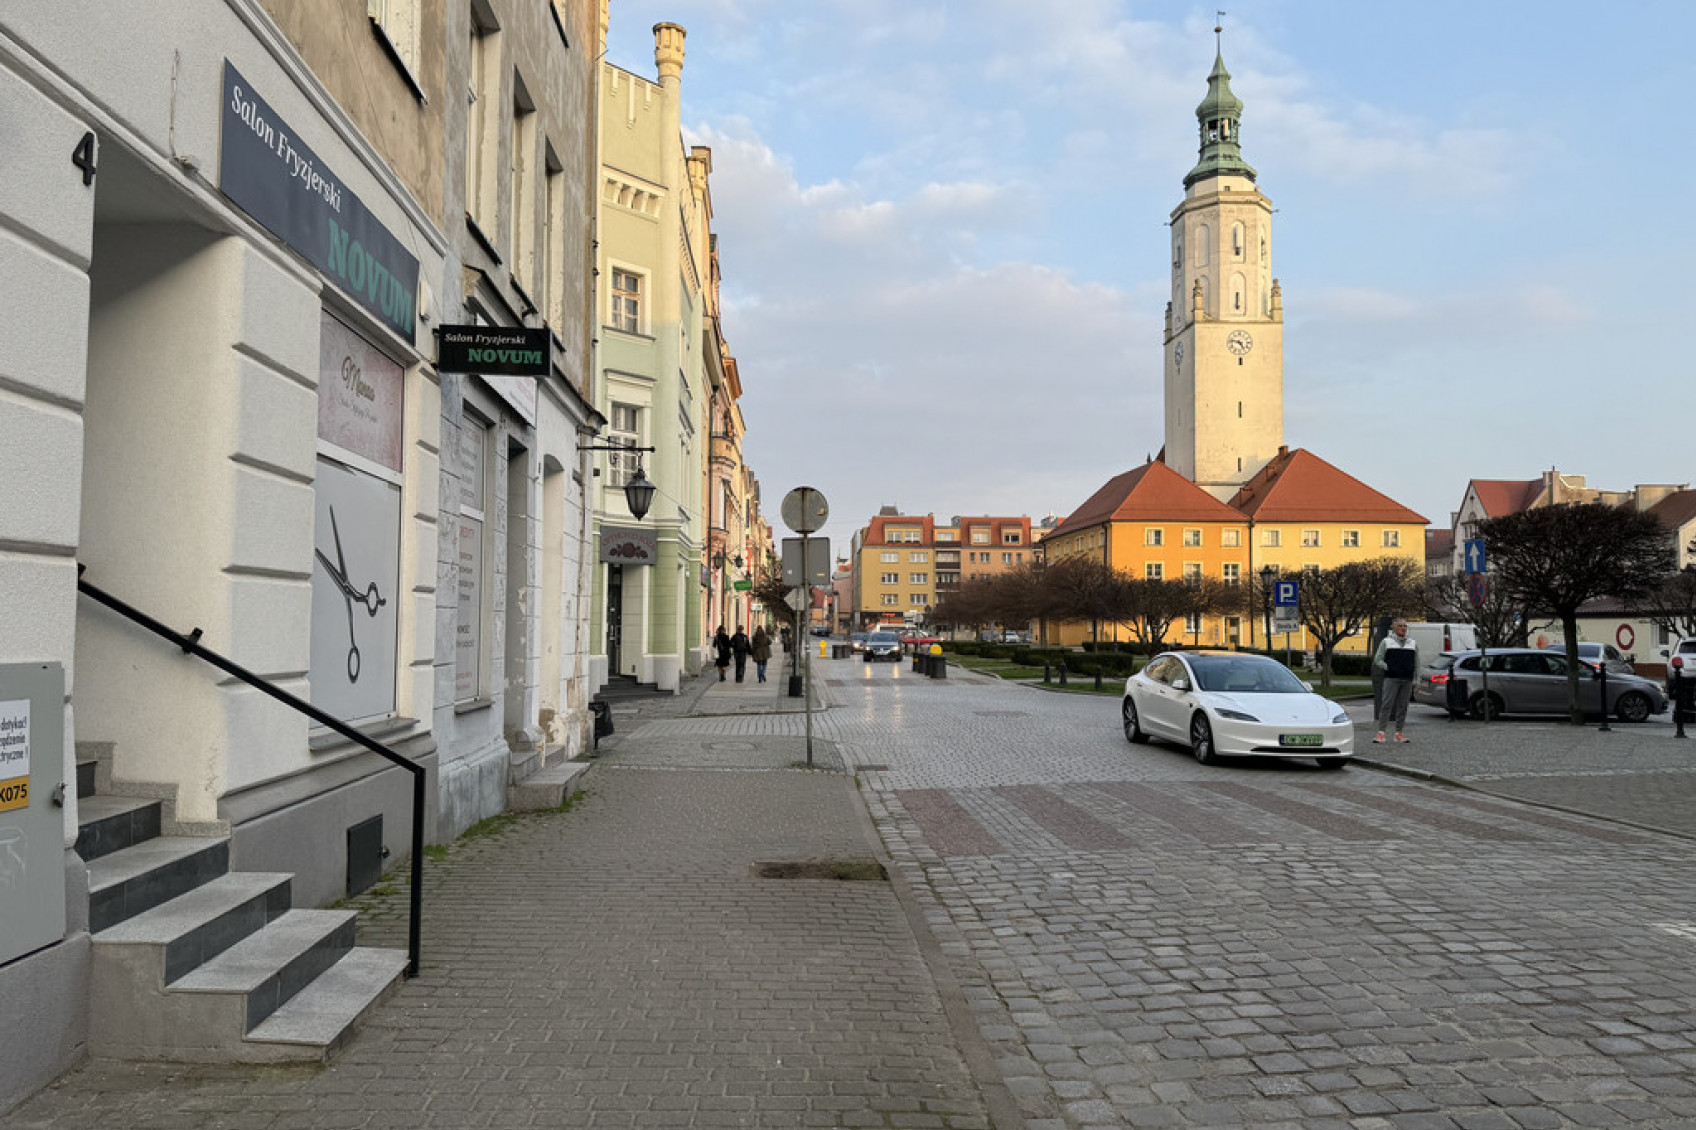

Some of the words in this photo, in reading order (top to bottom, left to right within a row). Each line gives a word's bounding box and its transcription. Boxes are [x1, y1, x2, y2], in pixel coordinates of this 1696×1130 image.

[71, 131, 96, 186] 4
[231, 85, 274, 150] Salon
[277, 131, 341, 213] Fryzjerski
[327, 218, 413, 335] NOVUM
[444, 333, 473, 343] Salon
[475, 334, 526, 345] Fryzjerski
[468, 348, 543, 365] NOVUM
